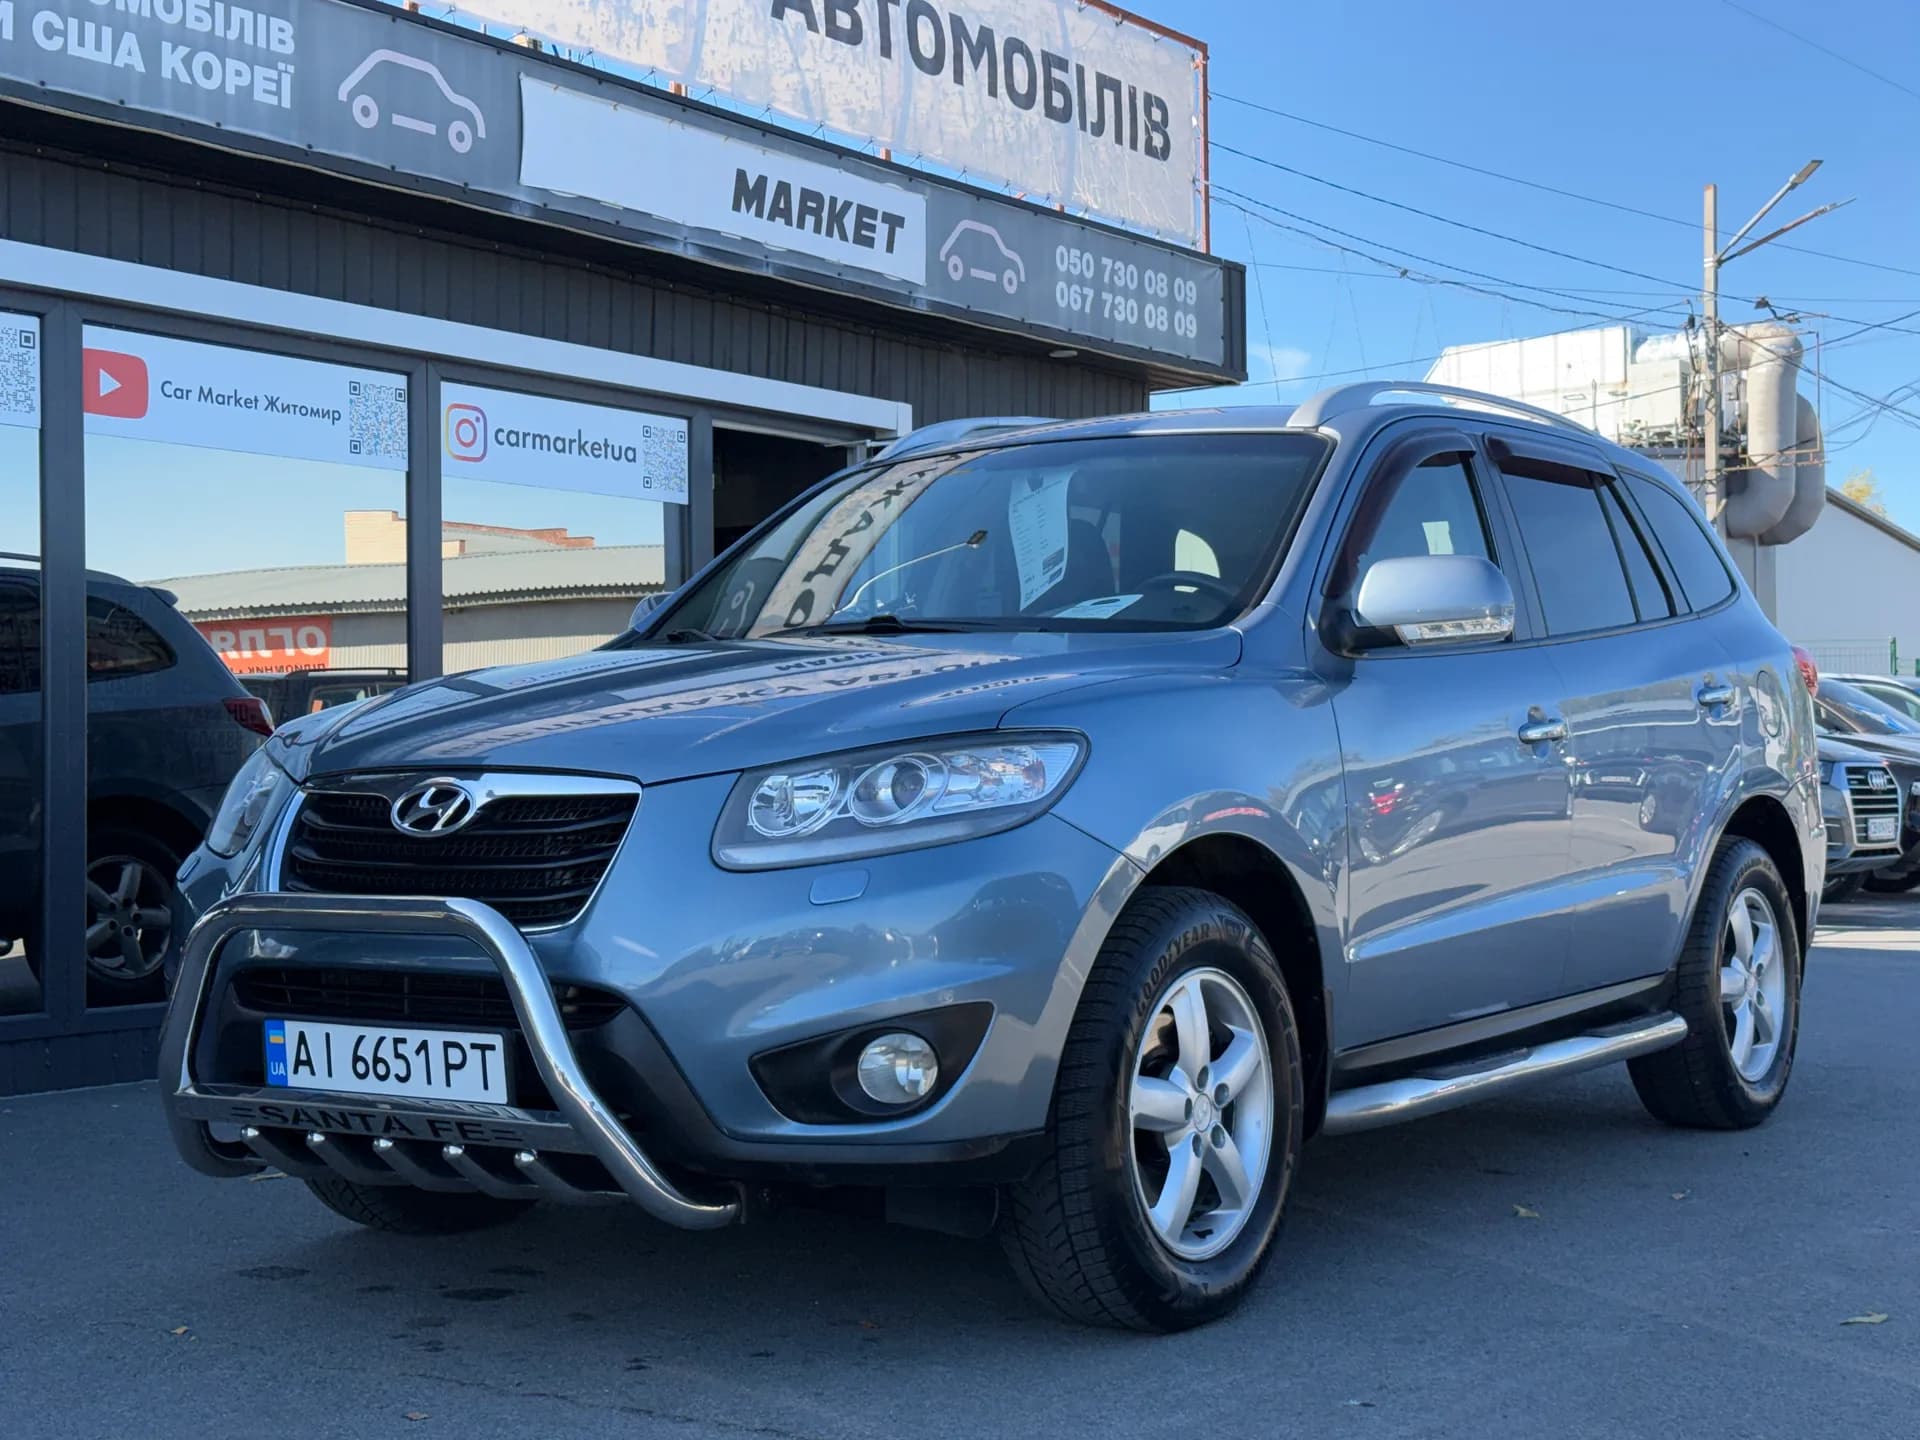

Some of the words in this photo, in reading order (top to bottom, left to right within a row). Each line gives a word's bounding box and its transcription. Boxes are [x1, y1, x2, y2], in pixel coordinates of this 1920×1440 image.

[32, 10, 146, 73] США
[161, 41, 296, 109] КОРЕЇ
[732, 168, 906, 254] MARKET
[1055, 244, 1094, 280] 050
[1101, 257, 1138, 291] 730
[1144, 268, 1168, 299] 08
[1174, 276, 1197, 306] 09
[1055, 281, 1094, 312] 067
[1101, 291, 1138, 325] 730
[1144, 302, 1168, 333] 08
[1174, 309, 1197, 339] 09
[160, 380, 193, 401] Car
[197, 385, 259, 411] Market
[264, 394, 342, 426] Житомир
[494, 429, 637, 464] carmarketua
[271, 1062, 287, 1076] UA
[293, 1030, 333, 1078] AI
[351, 1034, 432, 1085] 6651
[443, 1041, 497, 1091] PT
[258, 1105, 414, 1138] SANTA
[427, 1119, 491, 1143] FE
